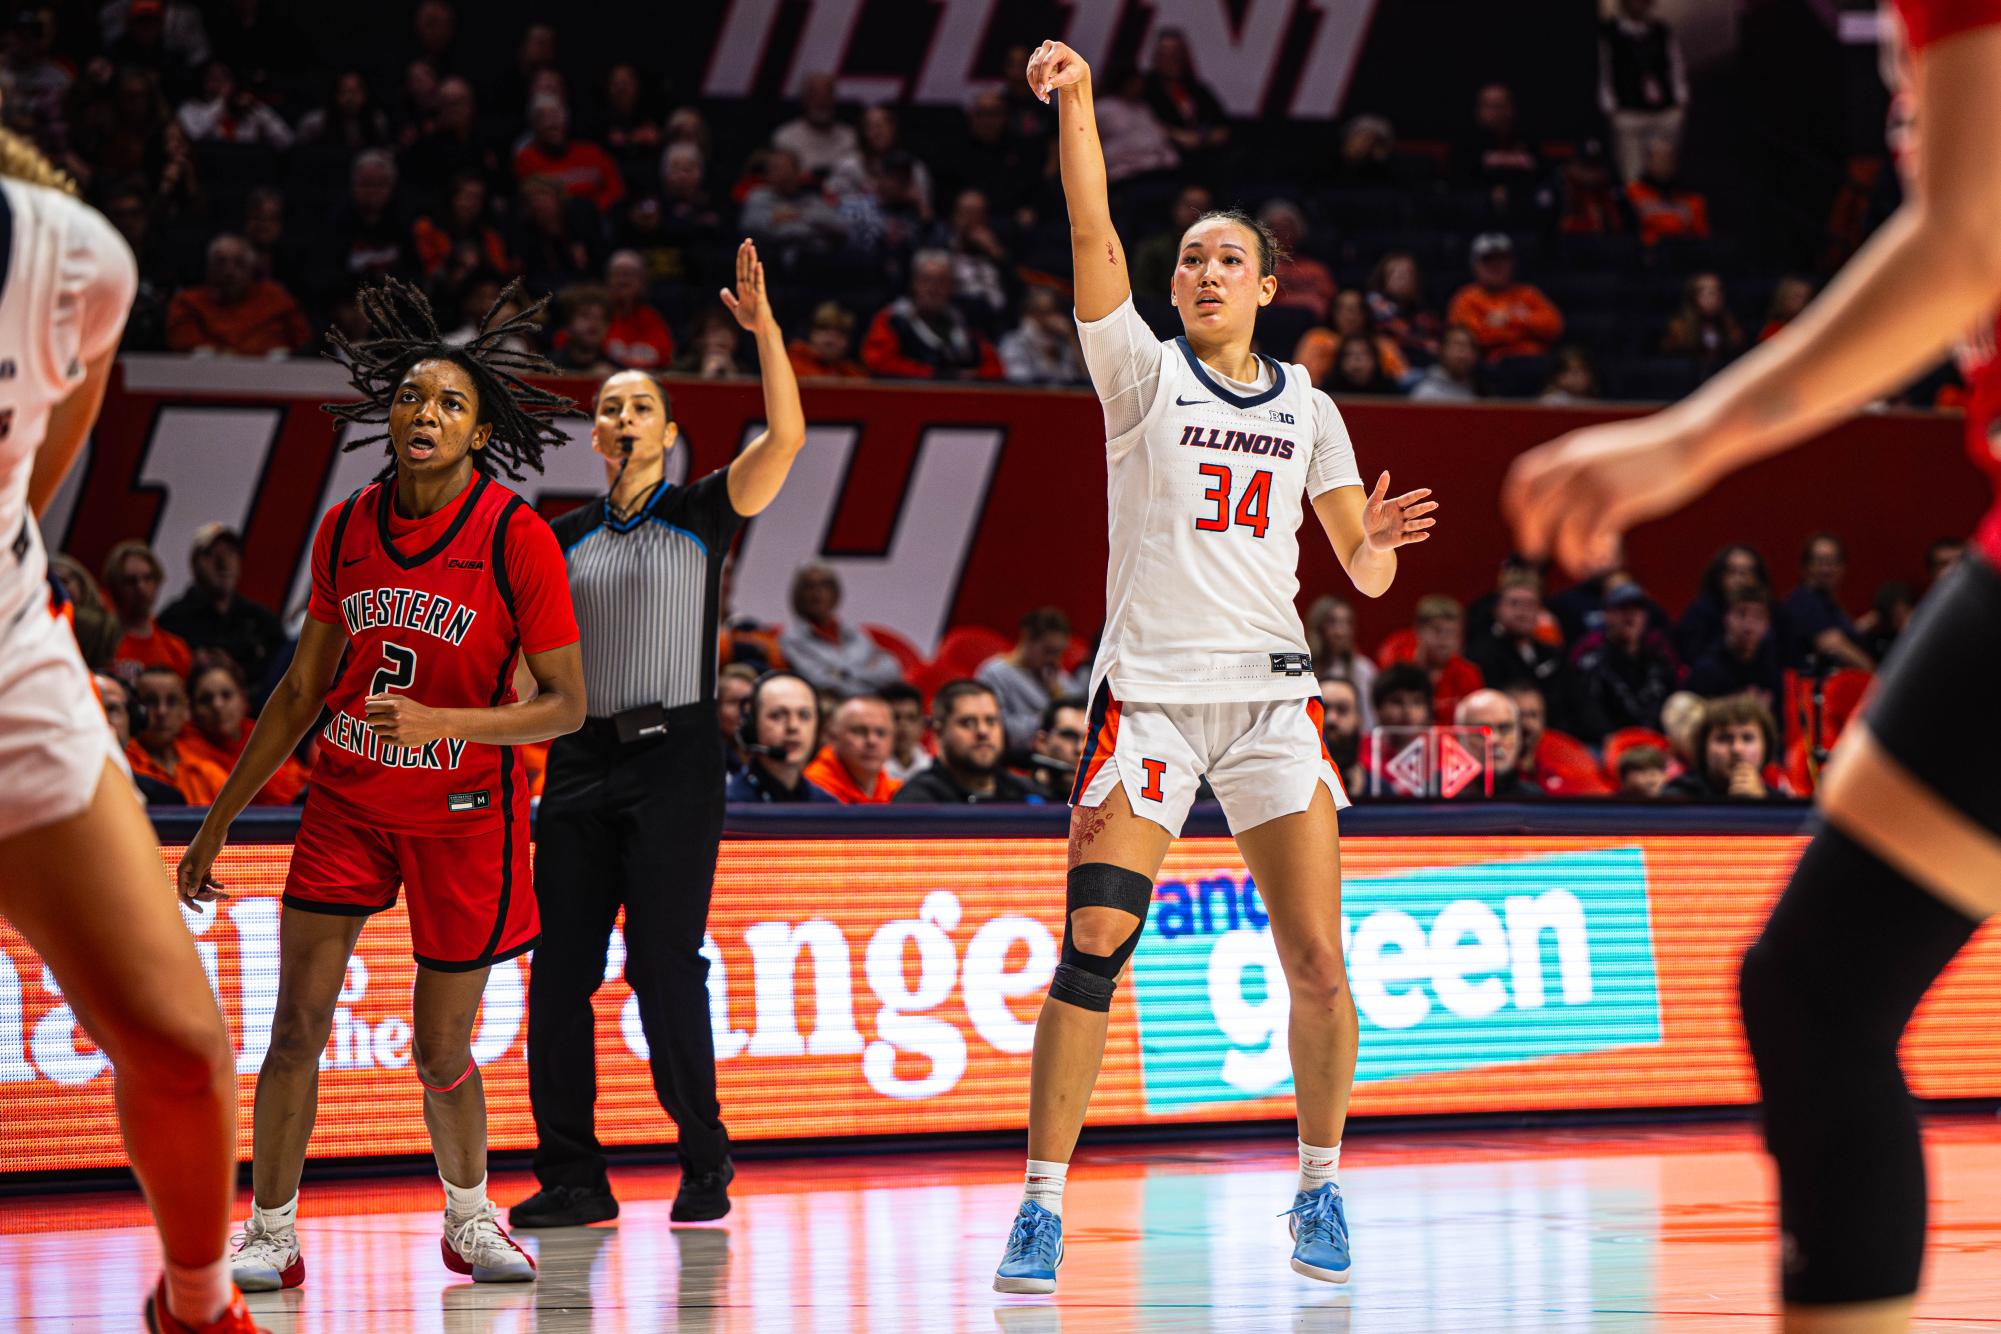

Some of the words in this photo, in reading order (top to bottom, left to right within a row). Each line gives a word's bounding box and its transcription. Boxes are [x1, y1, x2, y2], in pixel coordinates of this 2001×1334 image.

[1179, 425, 1295, 460] ILLINOIS
[1196, 463, 1273, 538] 34
[342, 588, 477, 647] WESTERN
[370, 641, 417, 697] 2
[1207, 888, 1593, 1092] geen
